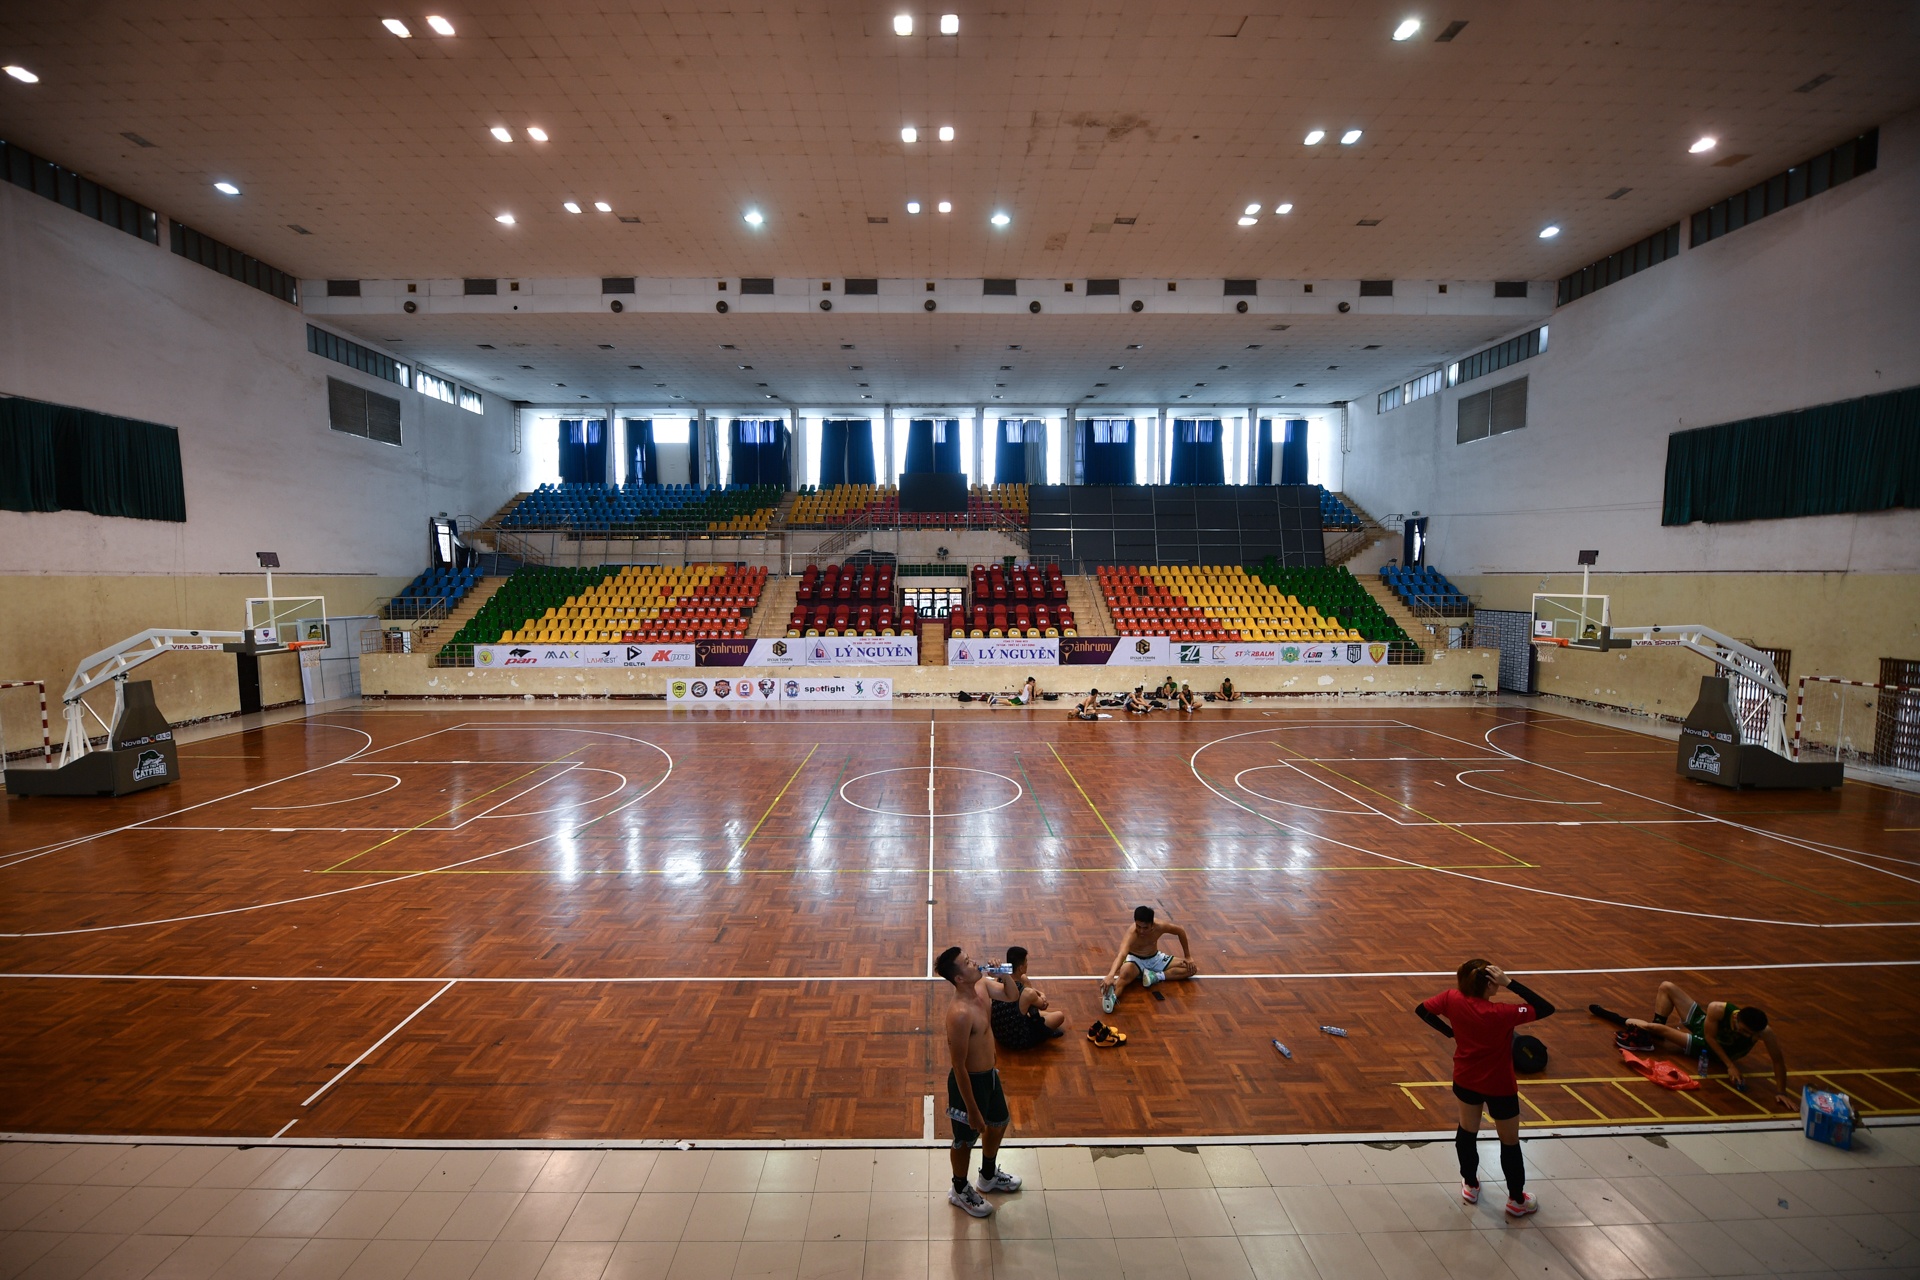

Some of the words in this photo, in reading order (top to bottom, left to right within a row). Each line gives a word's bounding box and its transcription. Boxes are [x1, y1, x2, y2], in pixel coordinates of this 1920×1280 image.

[544, 650, 579, 659] MAX
[835, 644, 853, 658] LÝ
[978, 646, 997, 660] LÝ
[504, 658, 537, 666] pan
[134, 764, 165, 779] CATFISH
[1690, 759, 1719, 773] CATFISH
